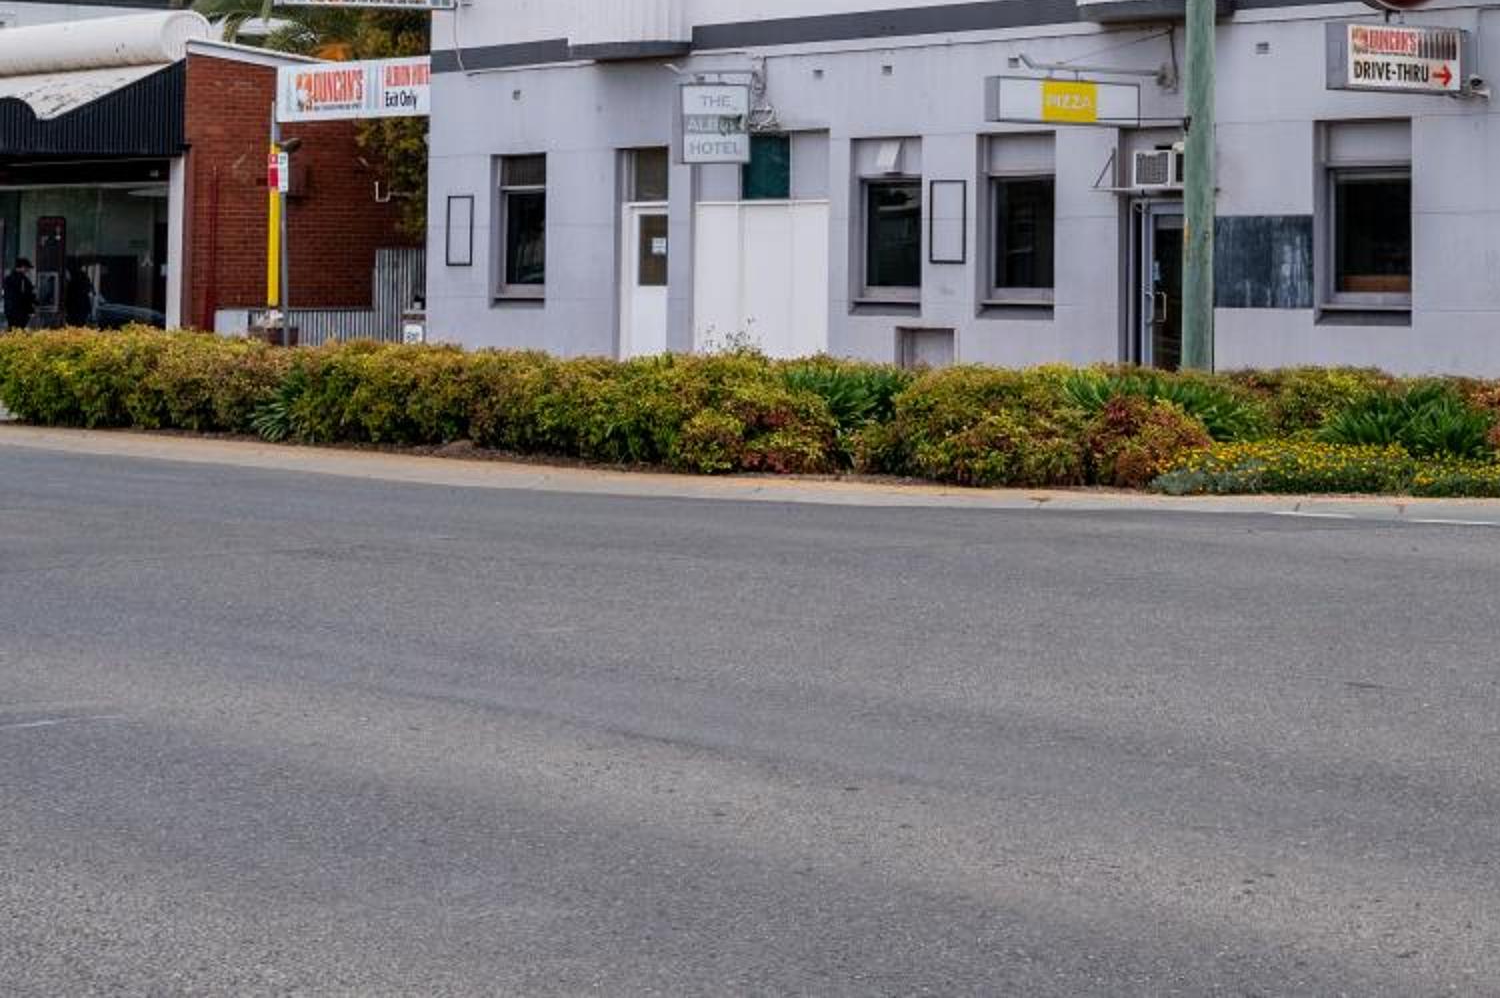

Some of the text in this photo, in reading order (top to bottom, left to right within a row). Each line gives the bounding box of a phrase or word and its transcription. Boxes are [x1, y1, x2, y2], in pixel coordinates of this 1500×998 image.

[1354, 61, 1429, 83] DRIVE-THRU
[385, 90, 417, 110] Exit Only
[701, 95, 732, 107] THE
[689, 141, 743, 155] HOTEL
